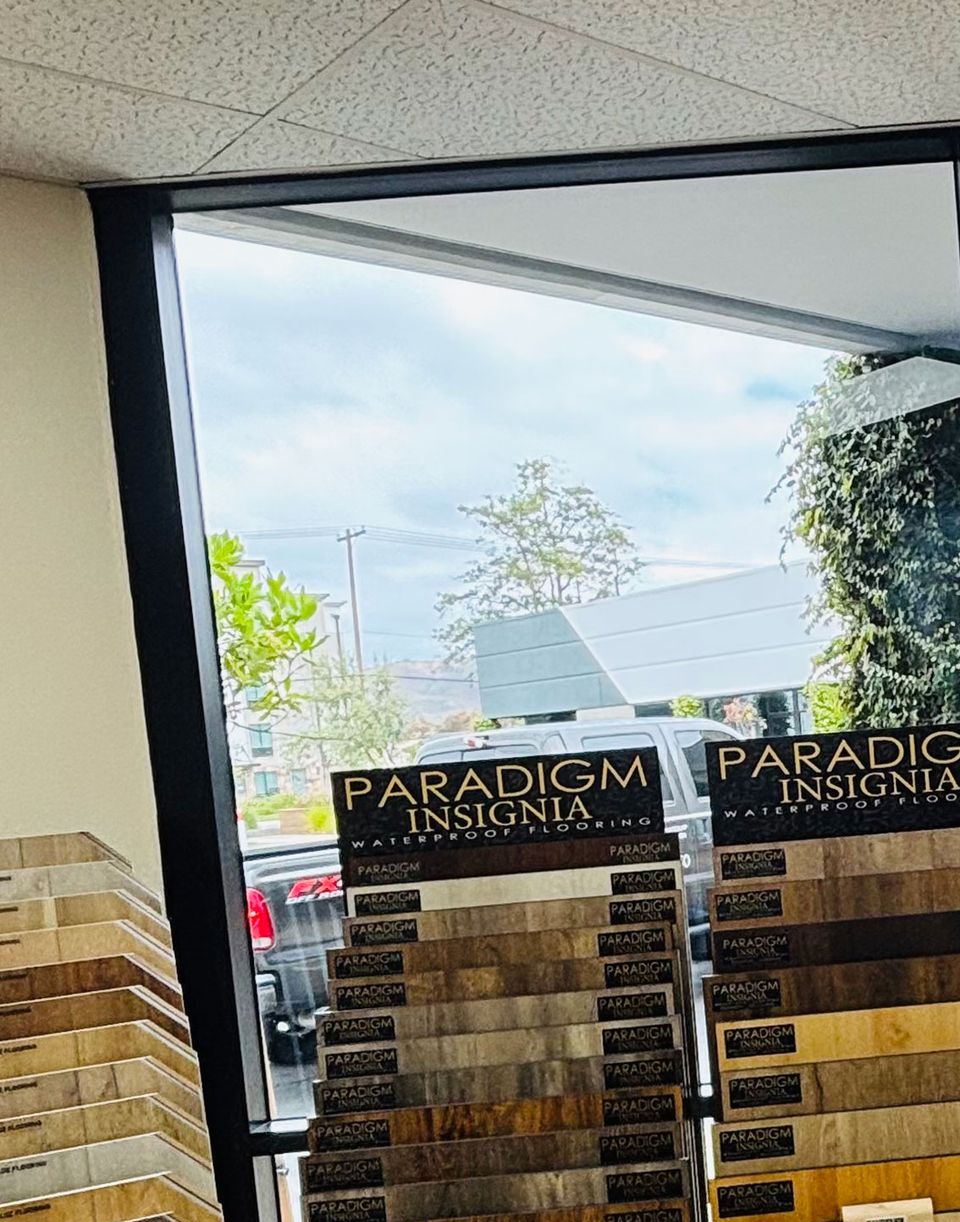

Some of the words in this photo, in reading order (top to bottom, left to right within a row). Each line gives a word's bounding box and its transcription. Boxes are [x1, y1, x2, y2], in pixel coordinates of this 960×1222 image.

[344, 755, 647, 810] PARADIGM
[406, 795, 593, 834] INSIGNIA
[724, 800, 882, 818] WATERPROOF
[352, 828, 512, 849] WATERPROOF
[529, 817, 651, 834] FLOORING
[610, 842, 671, 856] PARADIGM
[722, 850, 784, 864] PARADIGM
[358, 862, 420, 875] PARADIGM
[612, 871, 674, 885] PARADIGM
[288, 875, 342, 898] FX
[355, 891, 418, 905] PARADIGM
[717, 892, 779, 906] PARADIGM
[611, 900, 674, 914] PARADIGM
[351, 921, 415, 935] PARADIGM
[600, 932, 663, 945] PARADIGM
[723, 935, 787, 950] PARADIGM
[336, 952, 400, 967] PARADIGM
[606, 962, 670, 976] PARADIGM
[338, 985, 403, 998] PARADIGM
[713, 980, 778, 995] PARADIGM
[600, 995, 664, 1010] PARADIGM
[325, 1018, 392, 1032] PARADIGM
[604, 1027, 671, 1041] PARADIGM
[726, 1026, 793, 1040] PARADIGM
[328, 1051, 395, 1065] PARADIGM
[605, 1061, 673, 1076] PARADIGM
[731, 1076, 799, 1090] PARADIGM
[323, 1085, 392, 1100] PARADIGM
[604, 1098, 673, 1113] PARADIGM
[317, 1121, 387, 1137] PARADIGM
[722, 1128, 792, 1143] PARADIGM
[601, 1133, 671, 1148] PARADIGM
[308, 1161, 379, 1174] PARADIGM
[608, 1172, 680, 1189] PARADIGM
[719, 1183, 791, 1198] PARADIGM
[311, 1200, 383, 1214] PARADIGM
